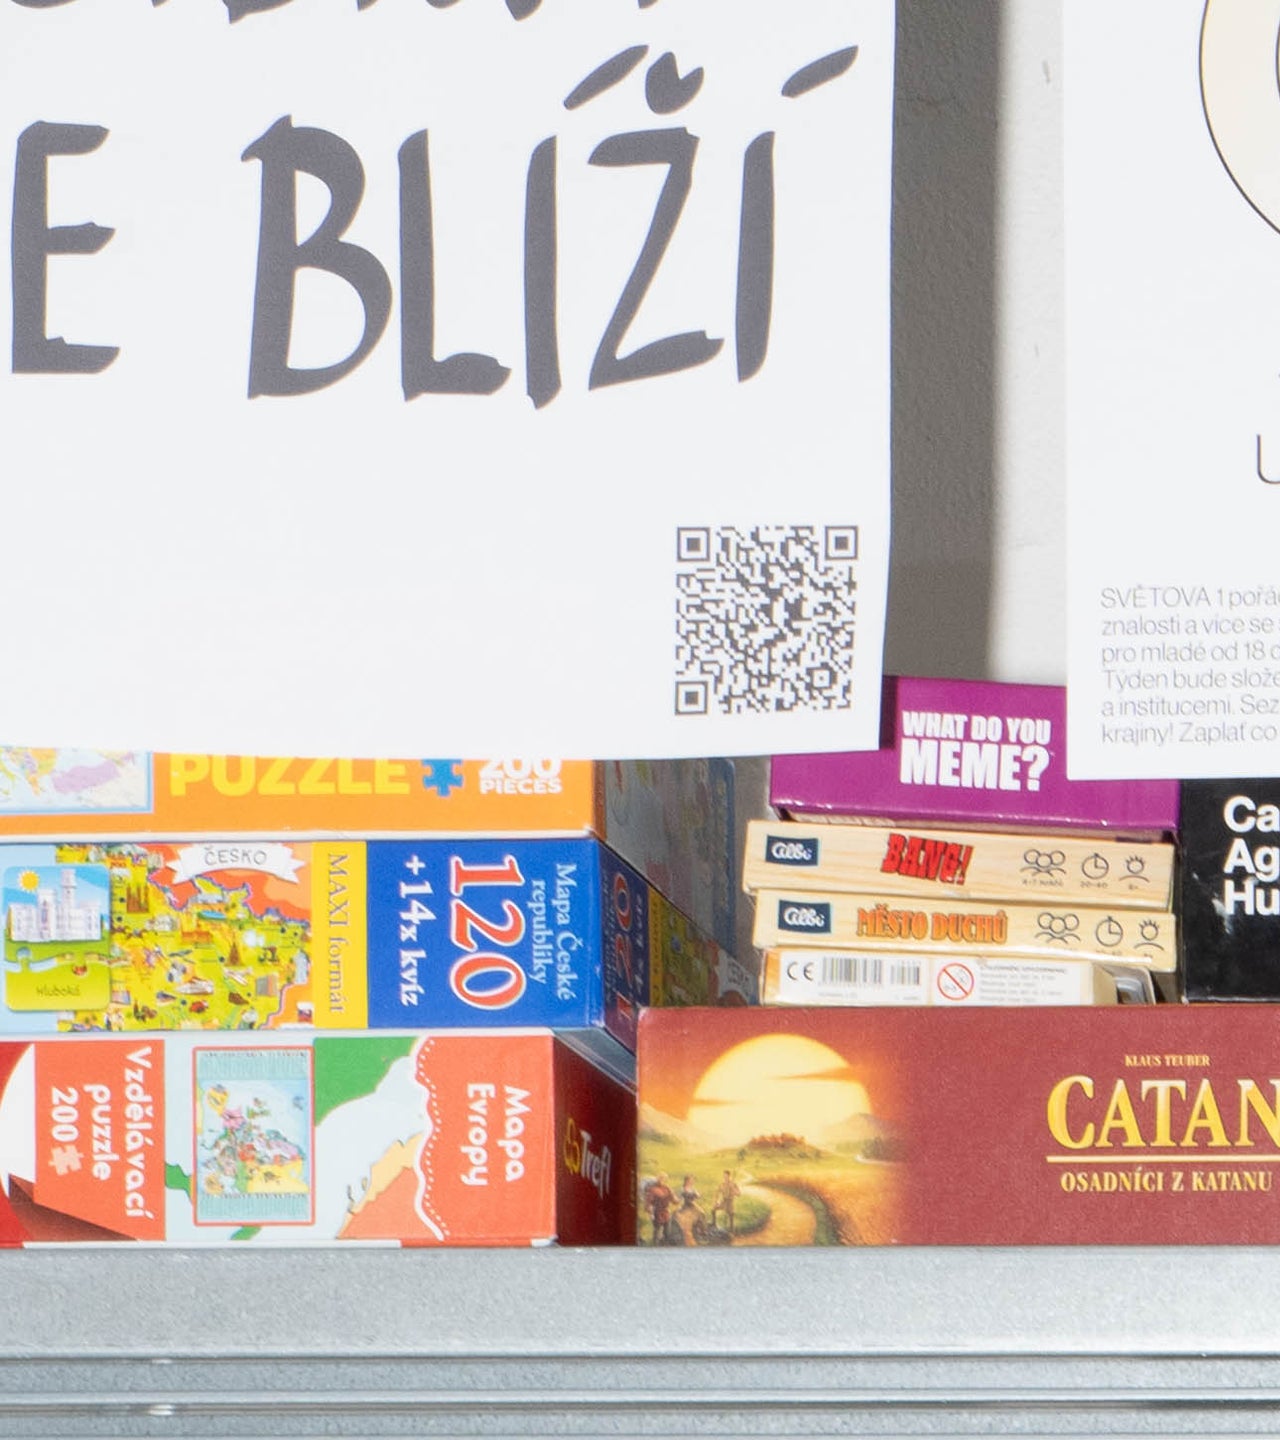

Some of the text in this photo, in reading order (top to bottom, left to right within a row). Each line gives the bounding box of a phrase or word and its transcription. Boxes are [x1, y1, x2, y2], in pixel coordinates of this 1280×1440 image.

[240, 44, 859, 410] BLÍŽÍ
[1099, 585, 1211, 607] SVĚTOVA
[169, 757, 413, 796] PUZZLE
[899, 742, 1050, 792] MEME?
[901, 710, 1052, 746] WHAT DO YOU
[479, 777, 563, 795] PIECES
[328, 854, 350, 1014] MAXI formát
[399, 880, 437, 1007] 14x kvíz
[448, 854, 527, 1011] 120
[526, 879, 552, 985] republiky
[554, 862, 585, 1001] Mapa České
[1124, 1054, 1211, 1067] KLAUS TEUBER
[51, 1086, 79, 1143] 200
[82, 1082, 123, 1182] puzzle
[124, 1045, 155, 1219] Vzdělávací
[459, 1082, 496, 1186] Evropy
[501, 1085, 532, 1182] Mapa
[1060, 1165, 1273, 1193] OSADNÍCI Z KATANU
